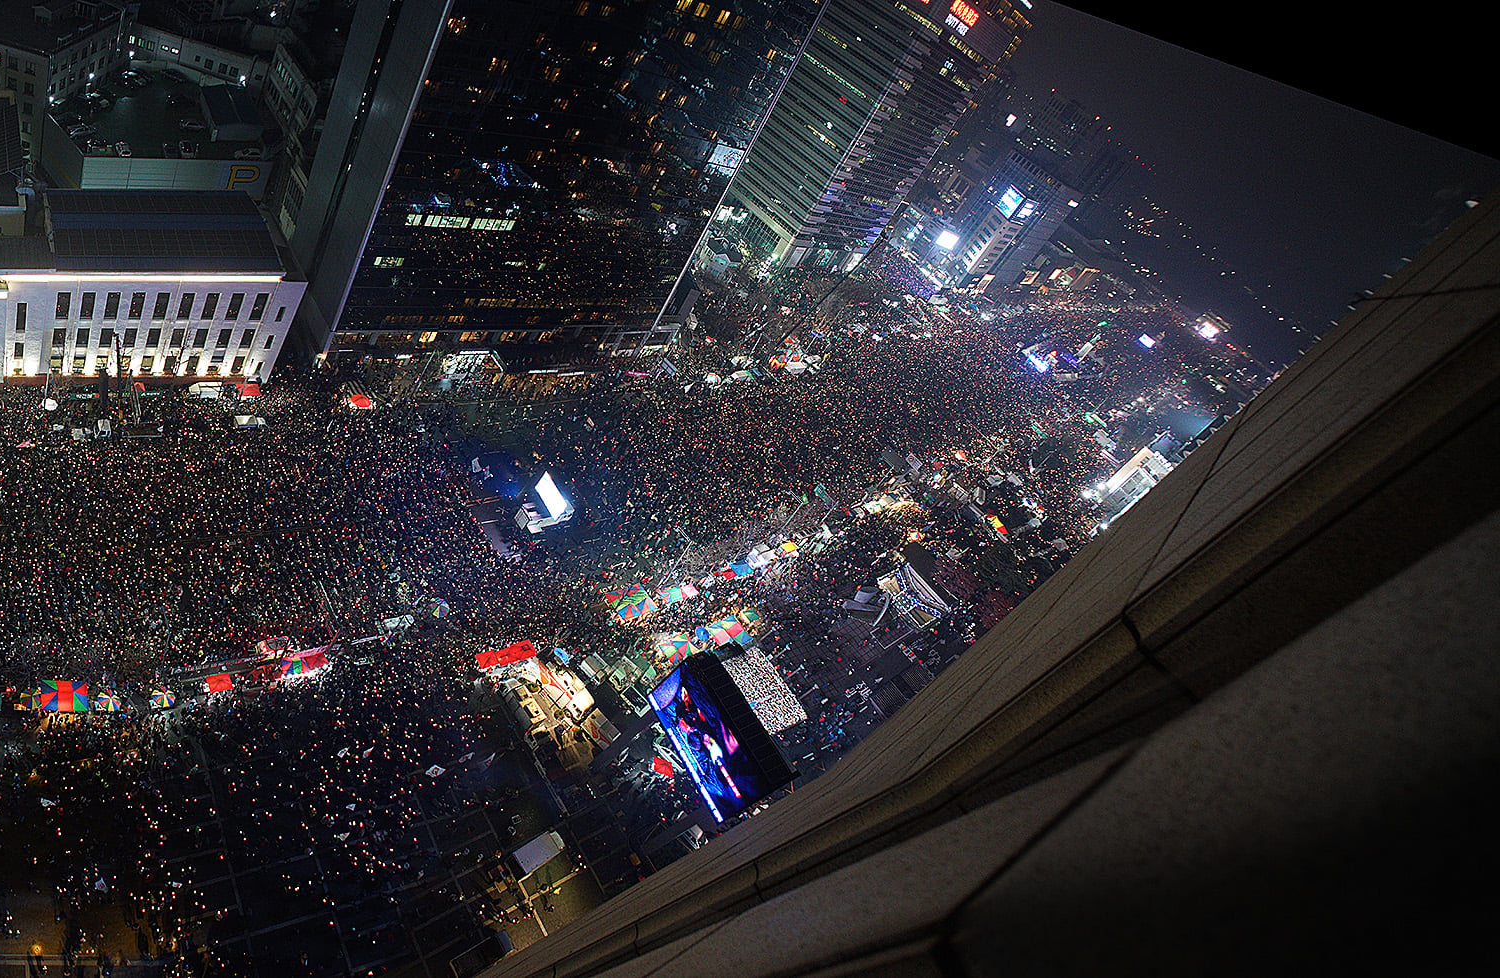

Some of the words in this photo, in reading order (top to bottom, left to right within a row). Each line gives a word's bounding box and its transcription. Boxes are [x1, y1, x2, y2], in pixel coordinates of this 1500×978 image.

[945, 13, 961, 28] DUTY
[956, 21, 970, 36] FREE
[228, 166, 260, 190] P
